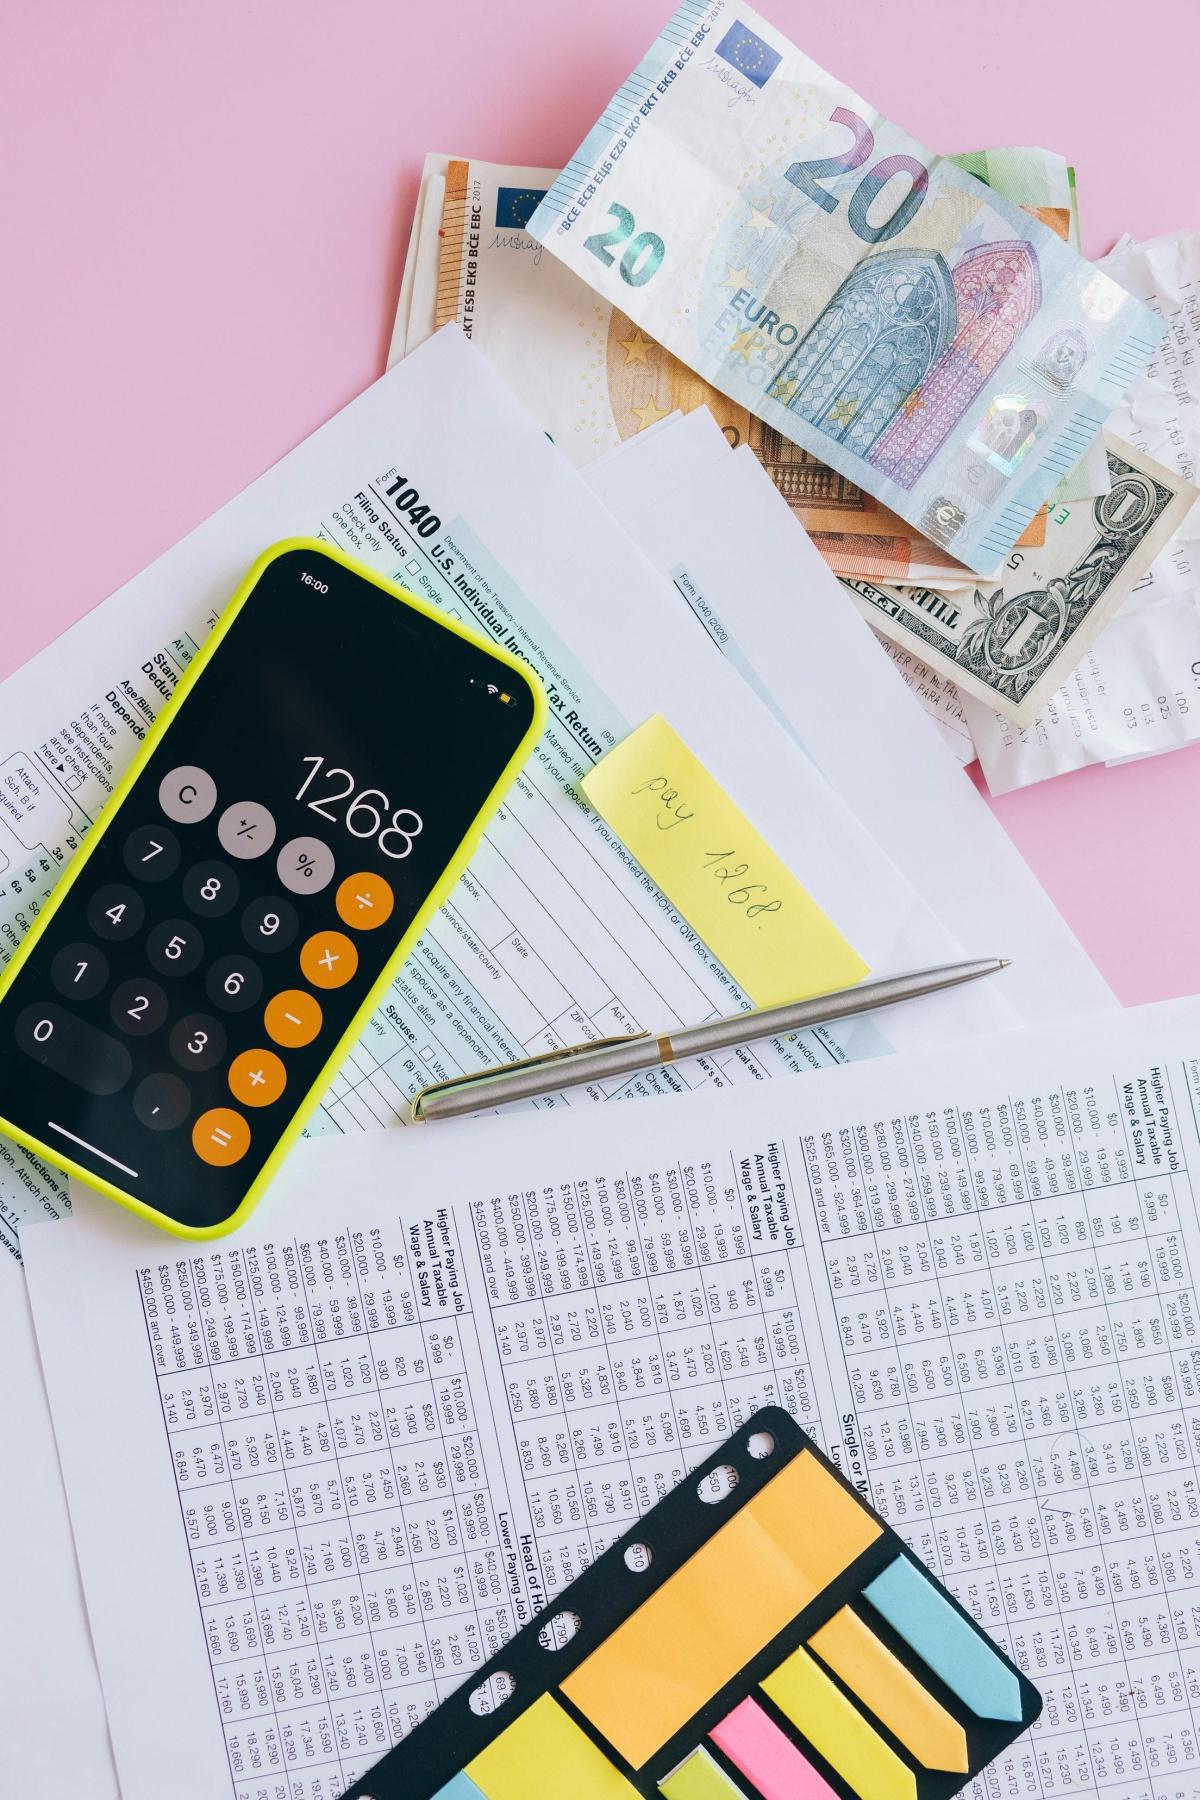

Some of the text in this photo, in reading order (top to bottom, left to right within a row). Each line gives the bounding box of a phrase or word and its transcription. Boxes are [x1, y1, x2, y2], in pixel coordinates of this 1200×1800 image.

[577, 183, 596, 207] ECB
[609, 138, 627, 160] EZB
[623, 115, 640, 138] EKP
[639, 92, 658, 116] EKT
[656, 69, 677, 93] EKB
[690, 23, 710, 47] EBC
[471, 179, 481, 202] 2017
[784, 106, 929, 243] 20
[469, 203, 482, 230] EBC
[583, 202, 665, 287] 20
[465, 260, 478, 286] EKB
[463, 288, 476, 313] ESB
[724, 285, 804, 349] EURO
[374, 467, 397, 485] Form
[353, 491, 407, 557] Filing Status
[385, 475, 441, 538] 1040
[330, 511, 362, 549] one box.
[342, 503, 383, 552] Check only
[300, 572, 328, 593] 16:00
[418, 575, 442, 604] Single
[443, 535, 476, 575] Department
[473, 573, 485, 583] of
[480, 580, 492, 594] the
[536, 650, 561, 679] Revenue
[559, 678, 580, 704] Service
[679, 573, 728, 643] Form 1040 (2020)
[430, 544, 602, 756] U.S. Individual Tax Return
[80, 711, 114, 751] than four
[88, 702, 116, 736] If more
[599, 729, 617, 747] (99)
[39, 743, 57, 764] here
[48, 736, 88, 785] and check
[58, 727, 113, 792] see instructions
[70, 721, 112, 775] dependents,
[543, 729, 586, 781] Married filin
[15, 767, 39, 795] Attach
[178, 785, 196, 804] C
[515, 776, 533, 799] name
[292, 756, 423, 861] 1268
[631, 776, 694, 831] pay
[51, 846, 64, 861] 3a
[64, 835, 78, 851] 2a
[141, 840, 163, 861] 7
[23, 867, 37, 884] 5a
[38, 858, 51, 873] 4a
[295, 853, 315, 877] %
[537, 752, 742, 1002] of your spouse. If you checked the HOH or QW box, enter the
[9, 879, 23, 895] 6a
[200, 877, 220, 900] 8
[459, 873, 480, 900] below.
[105, 903, 126, 924] 4
[259, 913, 279, 935] 9
[165, 935, 186, 959] 5
[511, 937, 528, 958] State
[74, 962, 87, 982] 1
[224, 972, 244, 994] 6
[422, 947, 449, 979] acquire
[447, 978, 465, 997] any
[462, 995, 495, 1032] financial
[127, 996, 148, 1019] 2
[394, 976, 435, 1025] status alien
[33, 1019, 53, 1041] 0
[187, 1031, 207, 1053] 3
[385, 1004, 417, 1043] Spouse:
[1122, 1082, 1145, 1164] Wage & Salary
[1136, 1078, 1162, 1164] Annual Taxable
[1149, 1067, 1180, 1171] Higher Paying Job
[15, 1168, 59, 1219] Attach Form
[6, 1211, 20, 1229] 11.
[409, 1224, 431, 1306] Wage & Salary
[423, 1220, 447, 1306] Annual Taxable
[436, 1208, 465, 1313] Higher Paying Job
[665, 1169, 726, 1431] $30,000 39,999 1,020 2,020 3,100
[996, 1104, 1105, 1596] $60,000 69,999 1,020 2,220 3,080 3,360 4,490 5,490 6,490
[263, 1243, 368, 1745] $100,000 124,999 2,040 4,440 5,870 7,160 8,360 9,560 11,240
[498, 1511, 528, 1621] Lower Paying Job
[519, 1534, 542, 1590] Head of
